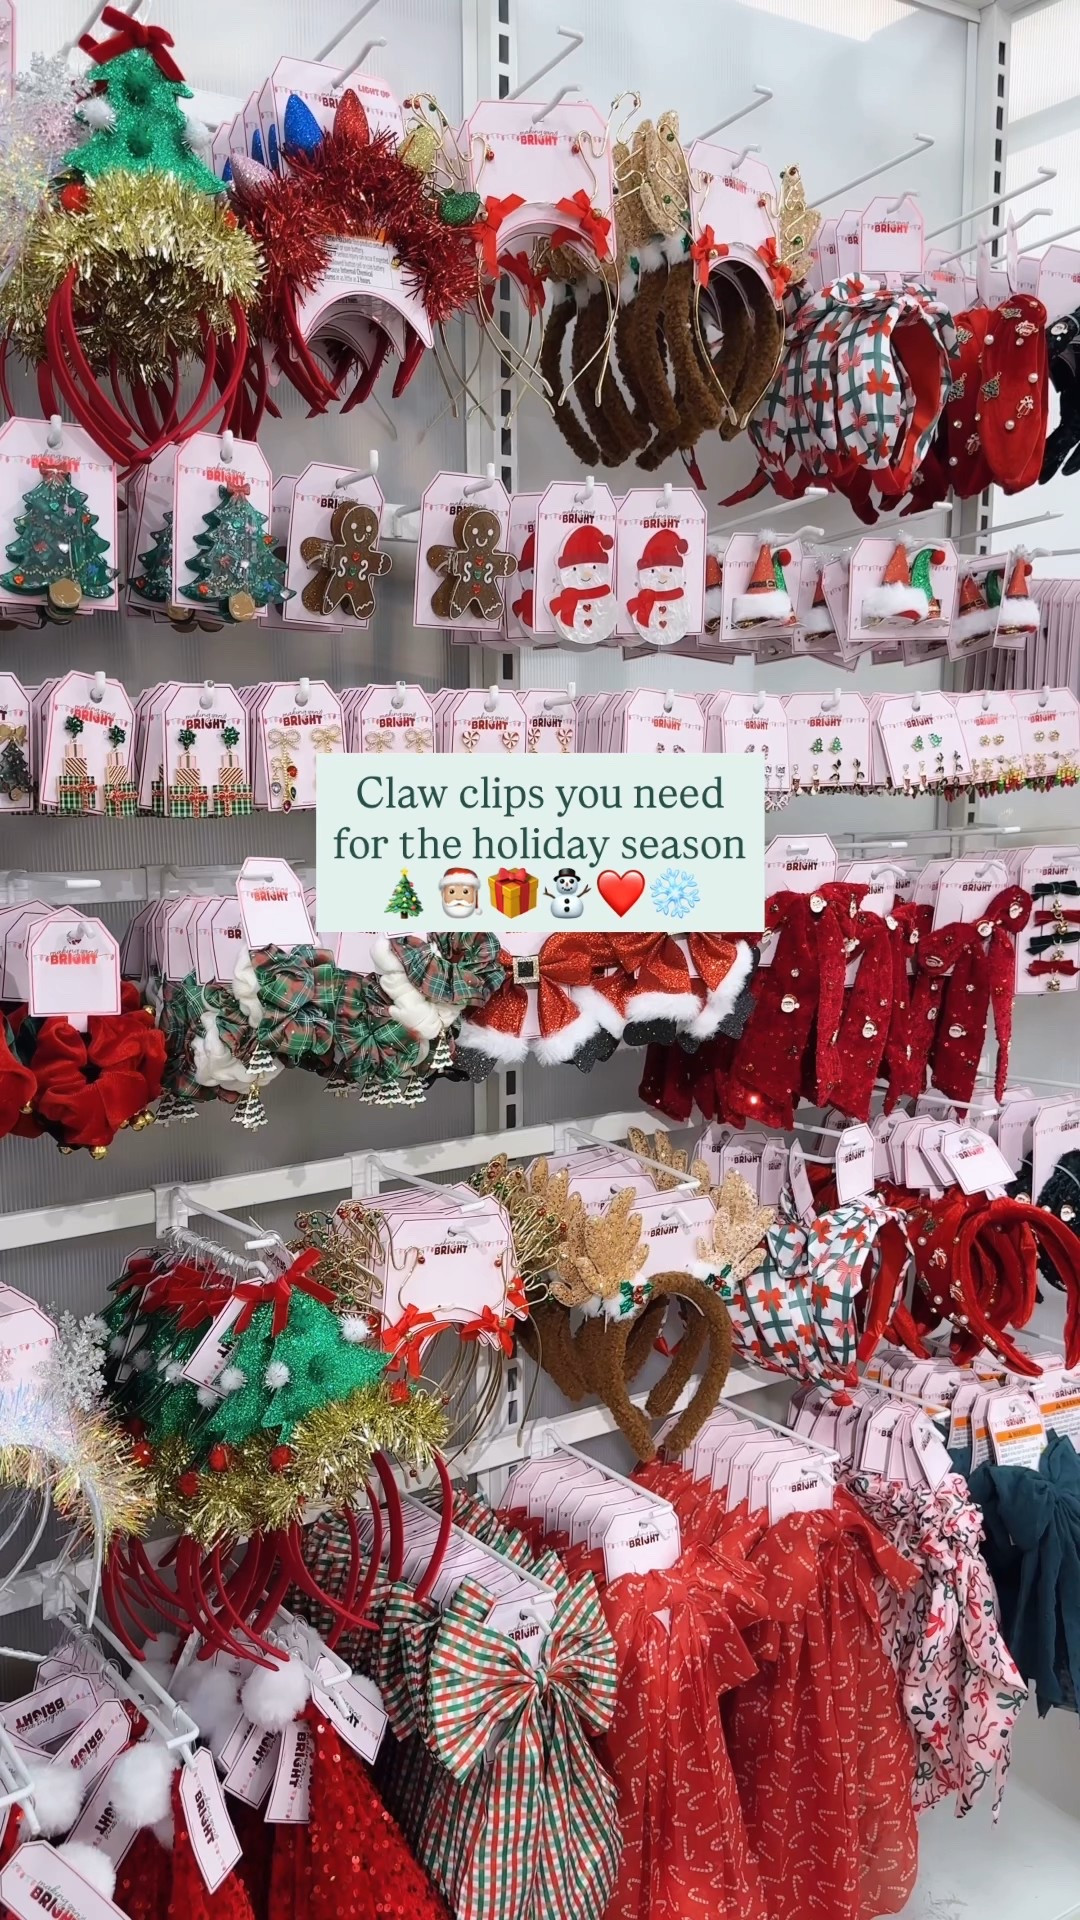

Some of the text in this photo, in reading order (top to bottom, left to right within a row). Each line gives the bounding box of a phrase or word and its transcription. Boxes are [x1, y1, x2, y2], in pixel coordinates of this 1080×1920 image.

[358, 84, 379, 96] LIGHT
[520, 134, 558, 146] BRIGHT
[724, 177, 748, 194] BRIGHT
[874, 223, 909, 234] BRIGHT
[206, 470, 245, 485] BRIGHT
[320, 498, 338, 509] BRI
[562, 513, 595, 524] BRIGHT
[643, 520, 680, 528] BRIGHT
[74, 706, 114, 726] BRIGHT
[283, 715, 323, 726] BRIGHT
[810, 716, 842, 727] BRIGHT
[975, 716, 999, 727] BRIGHT
[1030, 714, 1057, 724] BRIGHT
[186, 718, 226, 730] BRIGHT
[379, 717, 416, 728] BRIGHT
[471, 720, 508, 730] BRIGHT
[532, 718, 562, 728] BRIGHT
[653, 719, 681, 731] BRIGHT
[745, 720, 769, 731] BRIGHT
[906, 717, 934, 729] BRIGHT
[786, 862, 818, 871] BRIGHT
[1042, 867, 1069, 876] BRIGHT
[962, 884, 992, 892] BRIGHT
[254, 890, 289, 902] BRIGHT
[50, 953, 97, 965] BRIGHT
[734, 1155, 762, 1164] BRIGHT
[845, 1150, 865, 1163] BRIGHT
[650, 1225, 679, 1238] BRIGHT
[434, 1244, 468, 1256] BRIGHT
[1055, 1387, 1080, 1398] BRIGHT
[792, 1479, 818, 1492] BRIGHT
[628, 1533, 660, 1549] BRIGHT
[509, 1625, 540, 1641] BRIGHT
[16, 1697, 65, 1730] BRIGHT
[70, 1728, 104, 1769] BRIGH
[252, 1731, 275, 1766] IGHT
[289, 1731, 307, 1788] BRIGHT
[194, 1790, 215, 1845] BRIGHT
